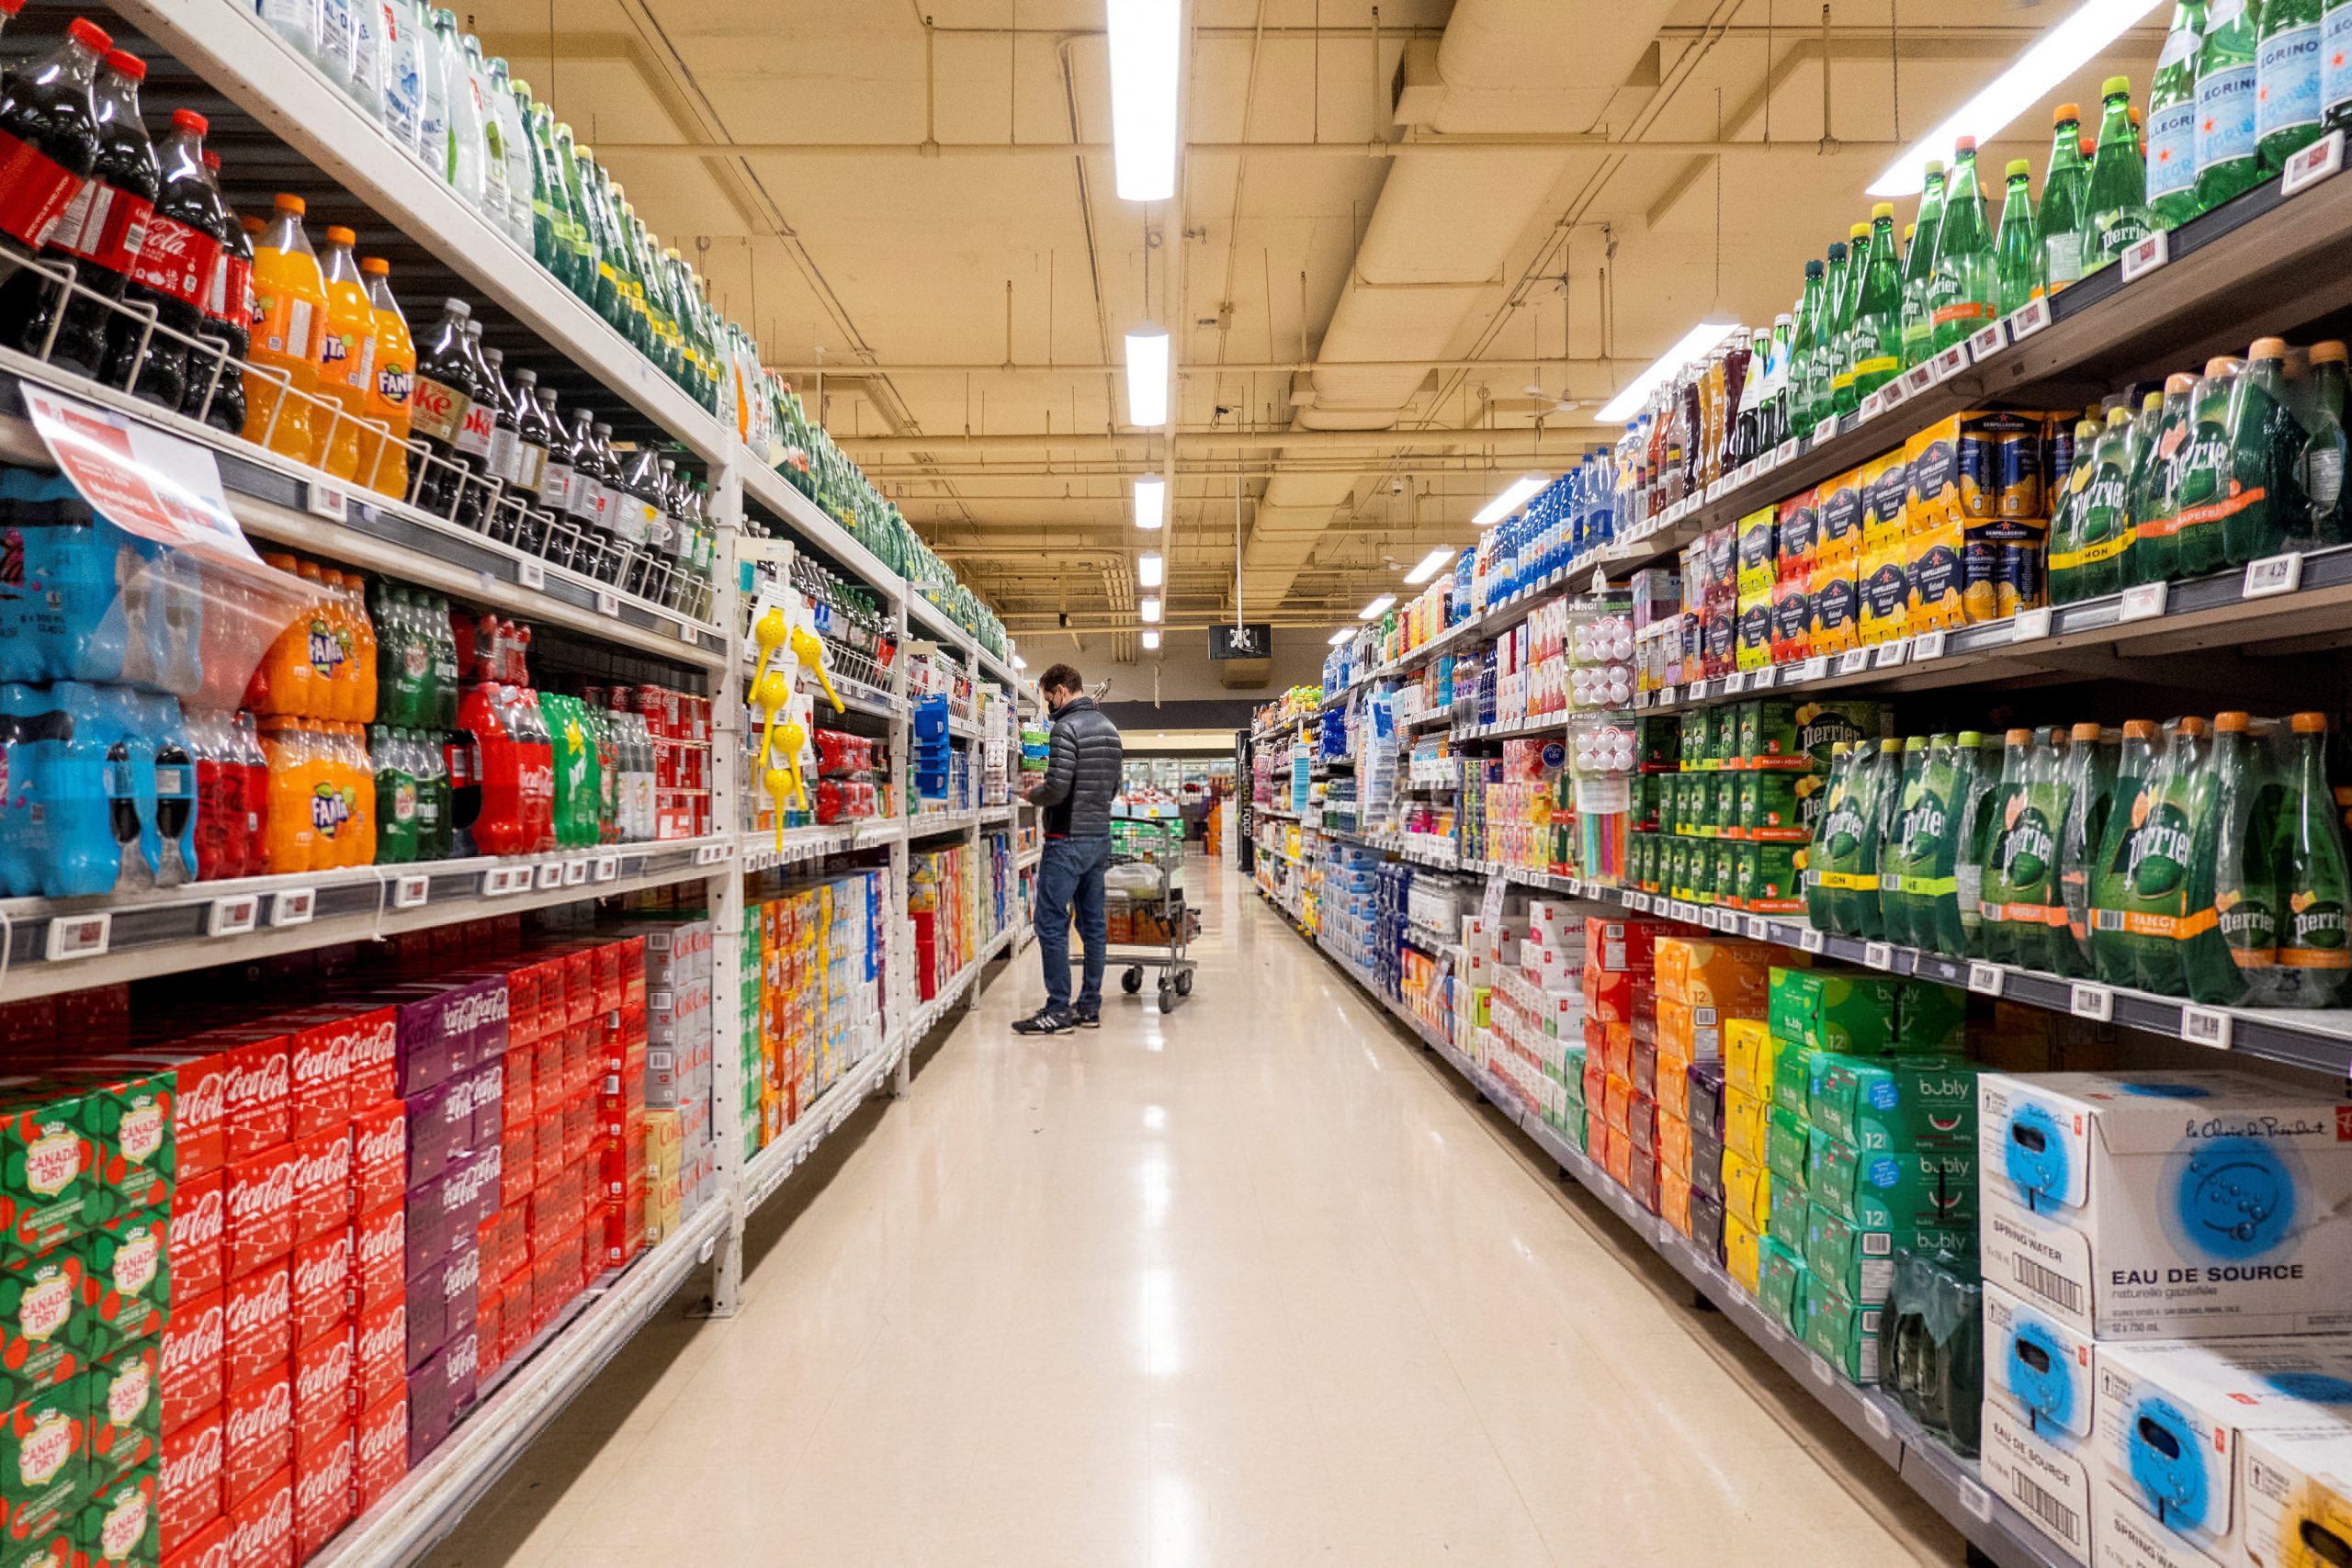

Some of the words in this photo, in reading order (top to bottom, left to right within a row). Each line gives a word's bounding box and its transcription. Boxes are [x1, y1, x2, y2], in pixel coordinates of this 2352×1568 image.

[1901, 302, 1919, 316] rier
[1851, 337, 1877, 351] rrier
[1809, 367, 1829, 378] rrier
[378, 371, 413, 394] FANT
[2085, 547, 2109, 559] MON
[2269, 562, 2288, 579] 4.29
[1801, 720, 1861, 759] perrier
[2219, 909, 2276, 933] perrie
[2293, 908, 2348, 944] perri
[1692, 991, 1707, 1002] 12
[1918, 1079, 1970, 1100] bubly
[119, 1117, 164, 1142] CANADA
[131, 1136, 151, 1151] DRY
[1864, 1133, 1883, 1148] 12
[26, 1146, 81, 1172] CANADA
[40, 1167, 65, 1184] DRY
[1864, 1210, 1883, 1226] 12
[1917, 1232, 1967, 1250] bubly
[1993, 1219, 2028, 1246] SPRING
[2029, 1238, 2063, 1263] WATER
[2111, 1269, 2158, 1286] EAU
[2168, 1268, 2199, 1283] DE
[2207, 1264, 2304, 1282] SOURCE
[18, 1285, 73, 1320] CANADA
[34, 1308, 59, 1331] DRY
